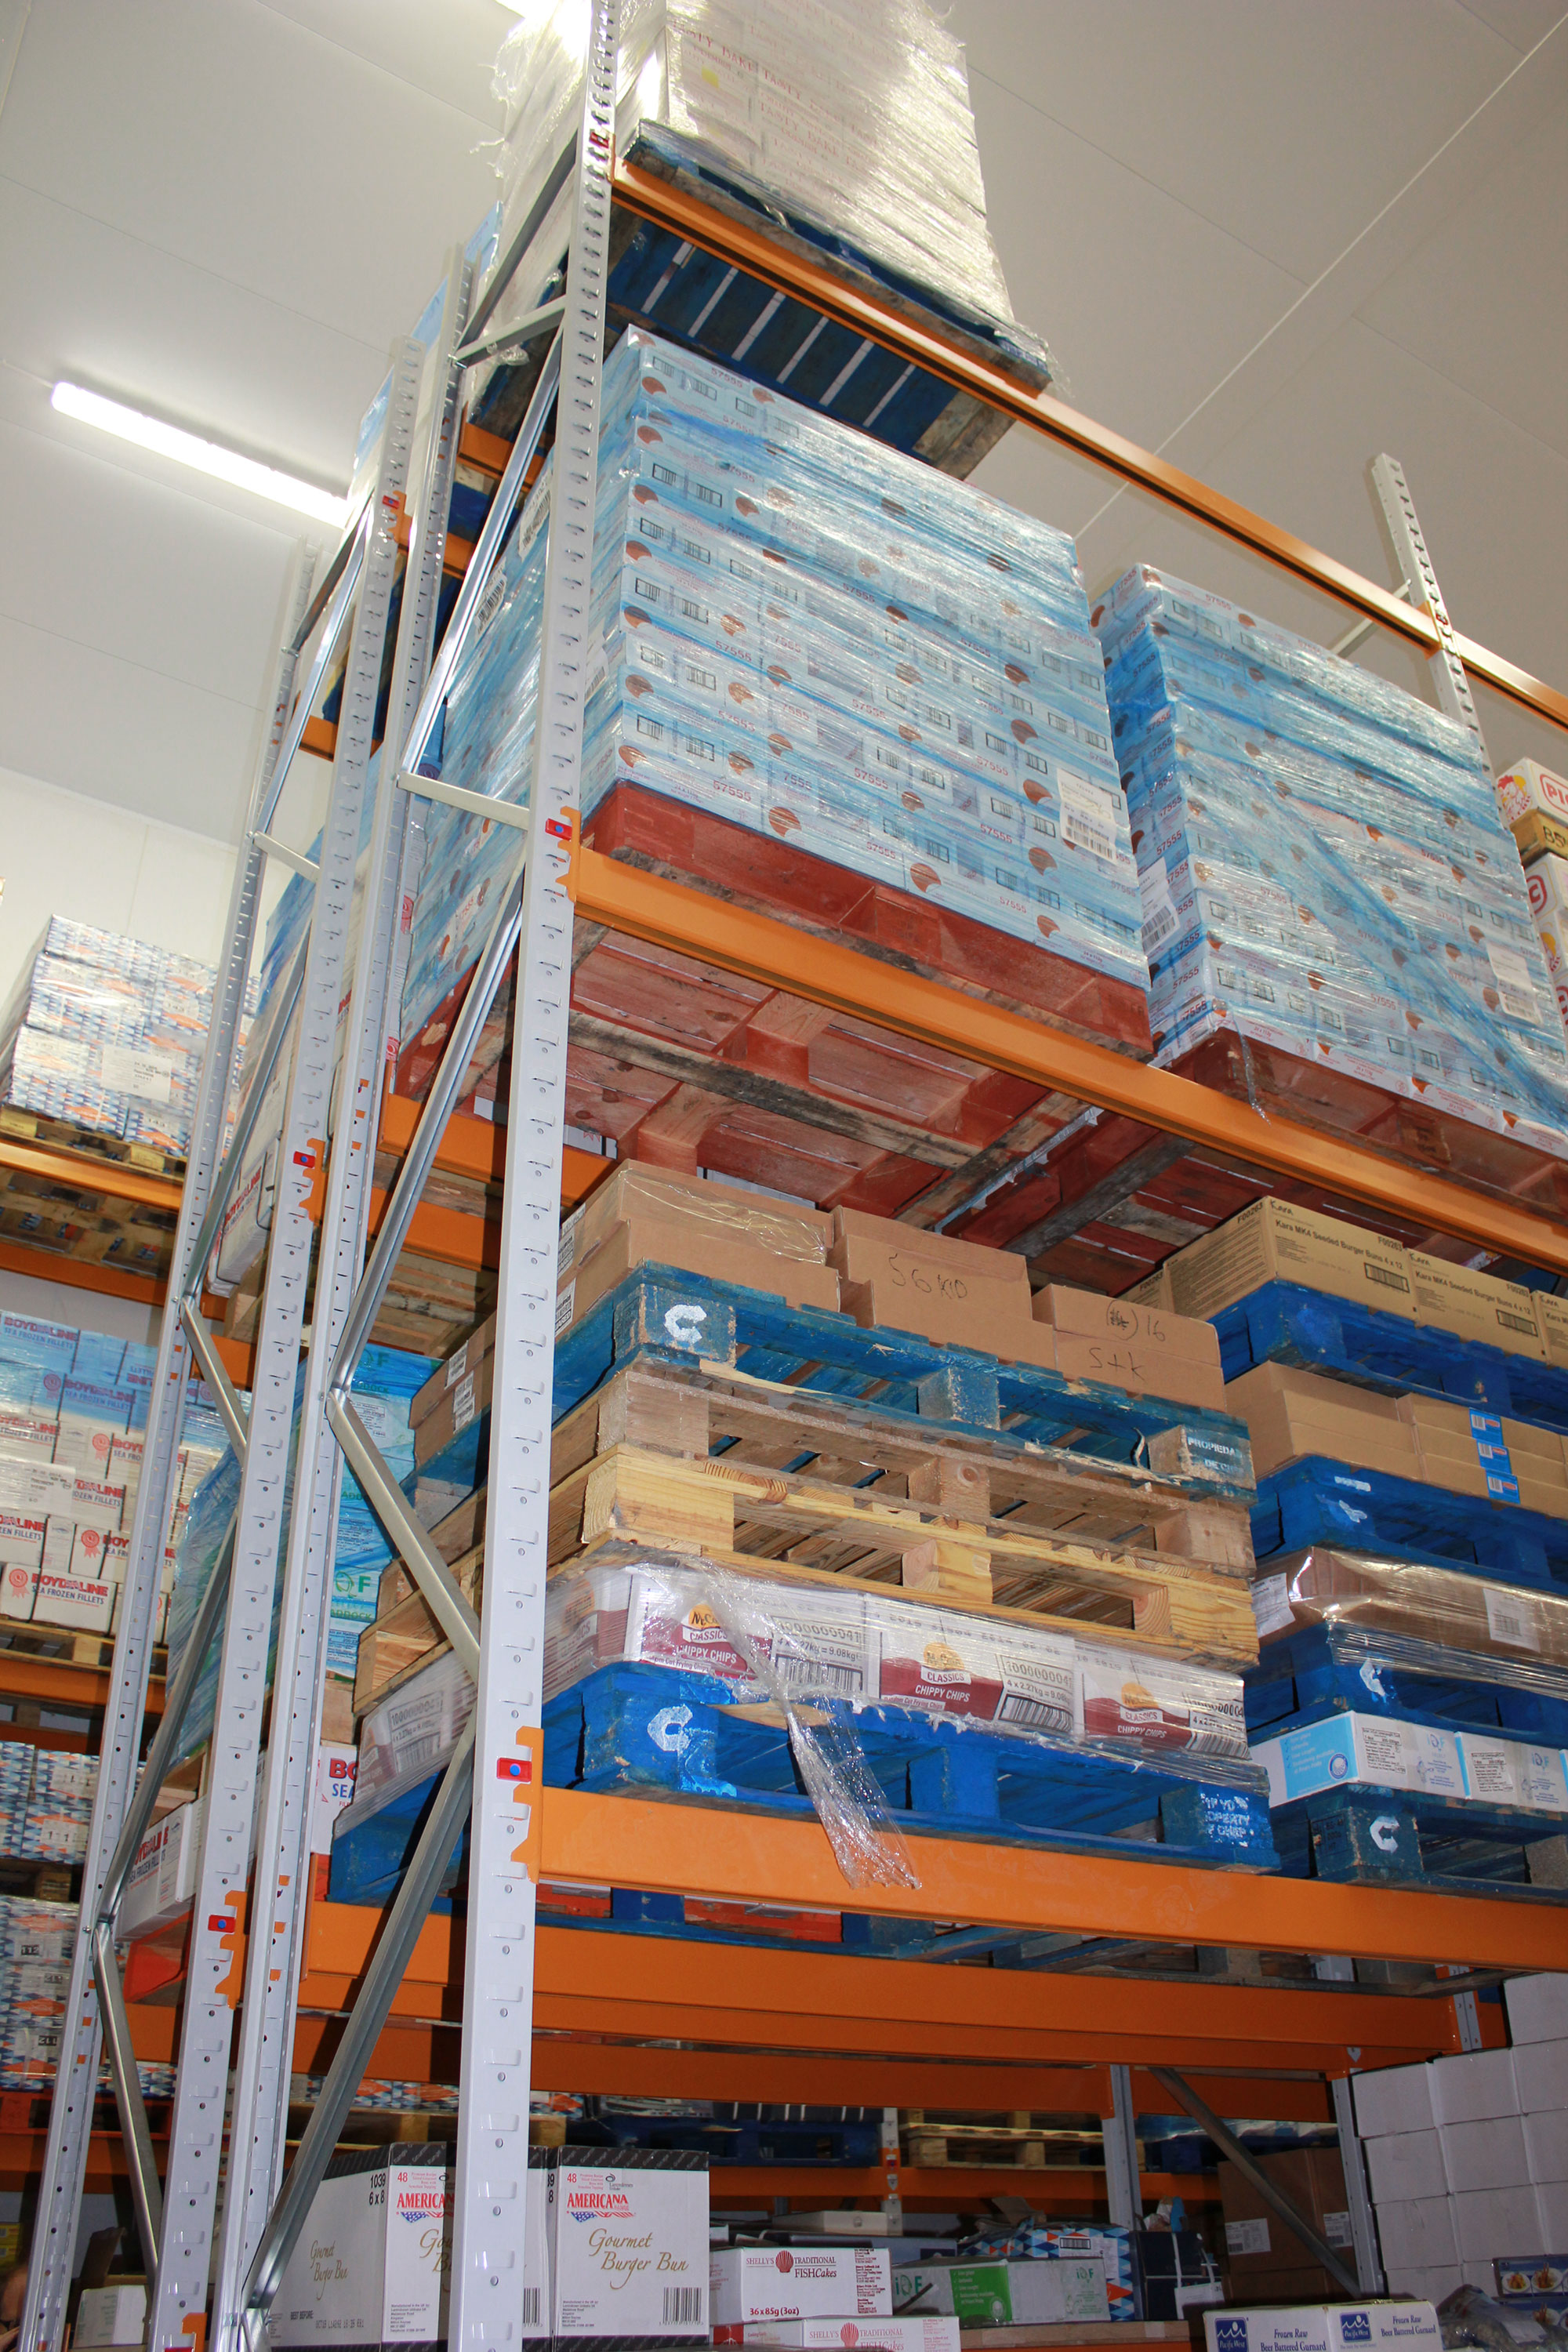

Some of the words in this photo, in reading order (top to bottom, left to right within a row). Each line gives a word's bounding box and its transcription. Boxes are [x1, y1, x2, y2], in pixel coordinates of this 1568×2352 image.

[716, 640, 753, 662] 57555
[977, 756, 1009, 776] 57555
[854, 768, 889, 789] 57555
[713, 780, 752, 802] 57555
[981, 823, 1013, 844] 57555
[1156, 830, 1182, 856] 57555
[866, 842, 895, 860] 57555
[1000, 896, 1027, 913] 57555
[1173, 965, 1200, 991] 57555
[1276, 1219, 1294, 1232] Kara
[1313, 1231, 1340, 1246] Seeded
[1341, 1240, 1364, 1255] Burger
[1366, 1249, 1383, 1261] Buns
[664, 1304, 707, 1345] C
[78, 1393, 106, 1406] FROZEN
[114, 1450, 127, 1460] SEA
[94, 1494, 121, 1507] FILLETS
[16, 1517, 45, 1531] LINE
[13, 1528, 42, 1541] FILLETS
[103, 1534, 129, 1548] BOY
[31, 1573, 67, 1589] BOYD
[79, 1581, 108, 1598] LINE
[32, 1585, 45, 1595] SEA
[47, 1588, 75, 1600] FROZEN
[77, 1592, 105, 1606] FILLETS
[330, 1609, 372, 1621] ADDOCK
[677, 1645, 709, 1659] CHIPPY
[710, 1650, 738, 1664] CHIPS
[676, 1660, 693, 1670] Frying
[693, 1663, 710, 1672] Chips
[927, 1671, 965, 1683] CLASSICS
[1007, 1679, 1013, 1687] 4
[915, 1685, 946, 1699] CHIPPY
[946, 1689, 971, 1704] CHIPS
[1125, 1711, 1158, 1722] CLASSICS
[1192, 1715, 1198, 1724] 4
[1117, 1725, 1145, 1735] CHIPPY
[1145, 1728, 1167, 1740] CHIPS
[1369, 1816, 1400, 1853] C
[370, 2173, 387, 2188] 1039
[397, 2172, 408, 2183] 48
[567, 2172, 577, 2183] 48
[368, 2191, 374, 2205] 6
[380, 2190, 386, 2204] 8
[567, 2192, 629, 2210] AMERICANA
[589, 2228, 653, 2257] Gourmet
[746, 2257, 775, 2266] SHELLY'S
[794, 2256, 837, 2265] TRADITIONAL
[601, 2251, 652, 2290] Burger
[656, 2252, 689, 2272] Bun
[781, 2307, 800, 2317] (3oz)
[1392, 2316, 1410, 2325] Frozen
[1410, 2315, 1421, 2324] Raw
[809, 2330, 839, 2339] SHELLY'S
[859, 2328, 903, 2337] TRADITIONAL
[1274, 2328, 1293, 2339] Frozen
[1294, 2328, 1308, 2339] Raw
[1381, 2328, 1393, 2337] Beer
[1393, 2326, 1415, 2336] Battered
[1417, 2325, 1436, 2336] Gurnard
[1261, 2343, 1274, 2352] Beer
[1275, 2343, 1298, 2352] Battered
[1300, 2341, 1327, 2352] Gurnard
